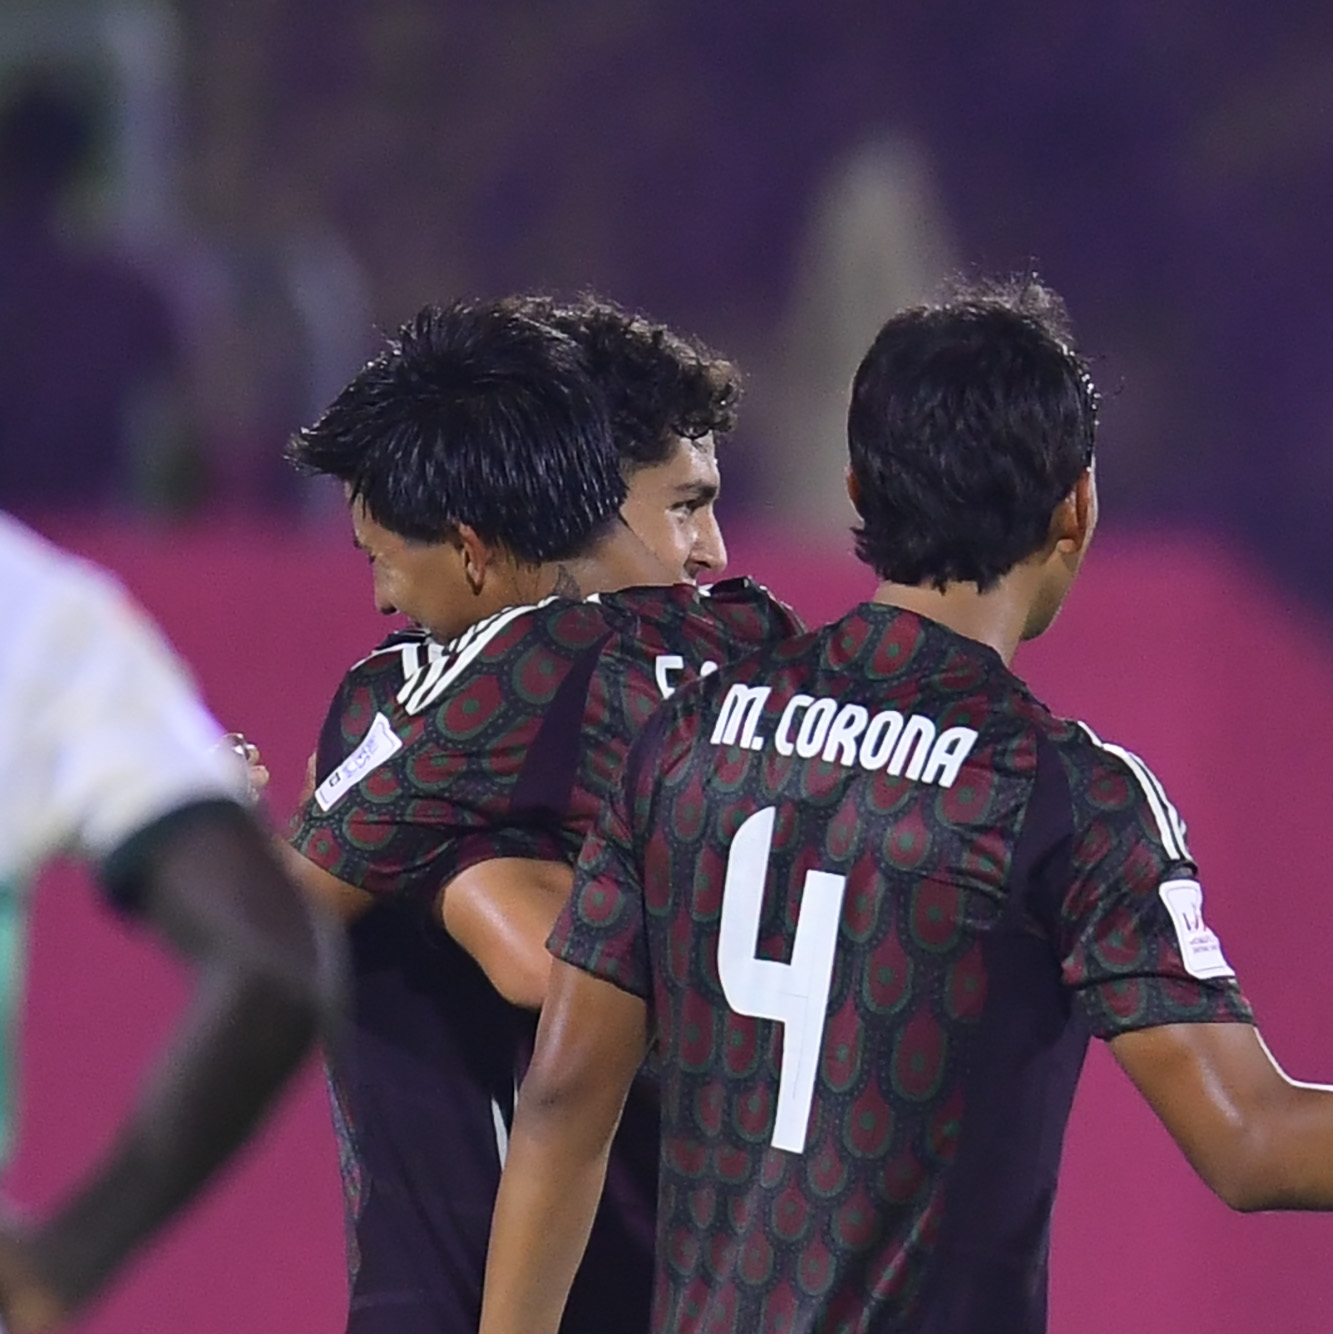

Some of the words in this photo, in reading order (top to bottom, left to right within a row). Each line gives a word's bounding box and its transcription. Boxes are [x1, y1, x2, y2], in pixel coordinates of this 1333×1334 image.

[710, 684, 772, 751] M.
[775, 695, 979, 788] CORONA
[718, 806, 846, 1154] 4
